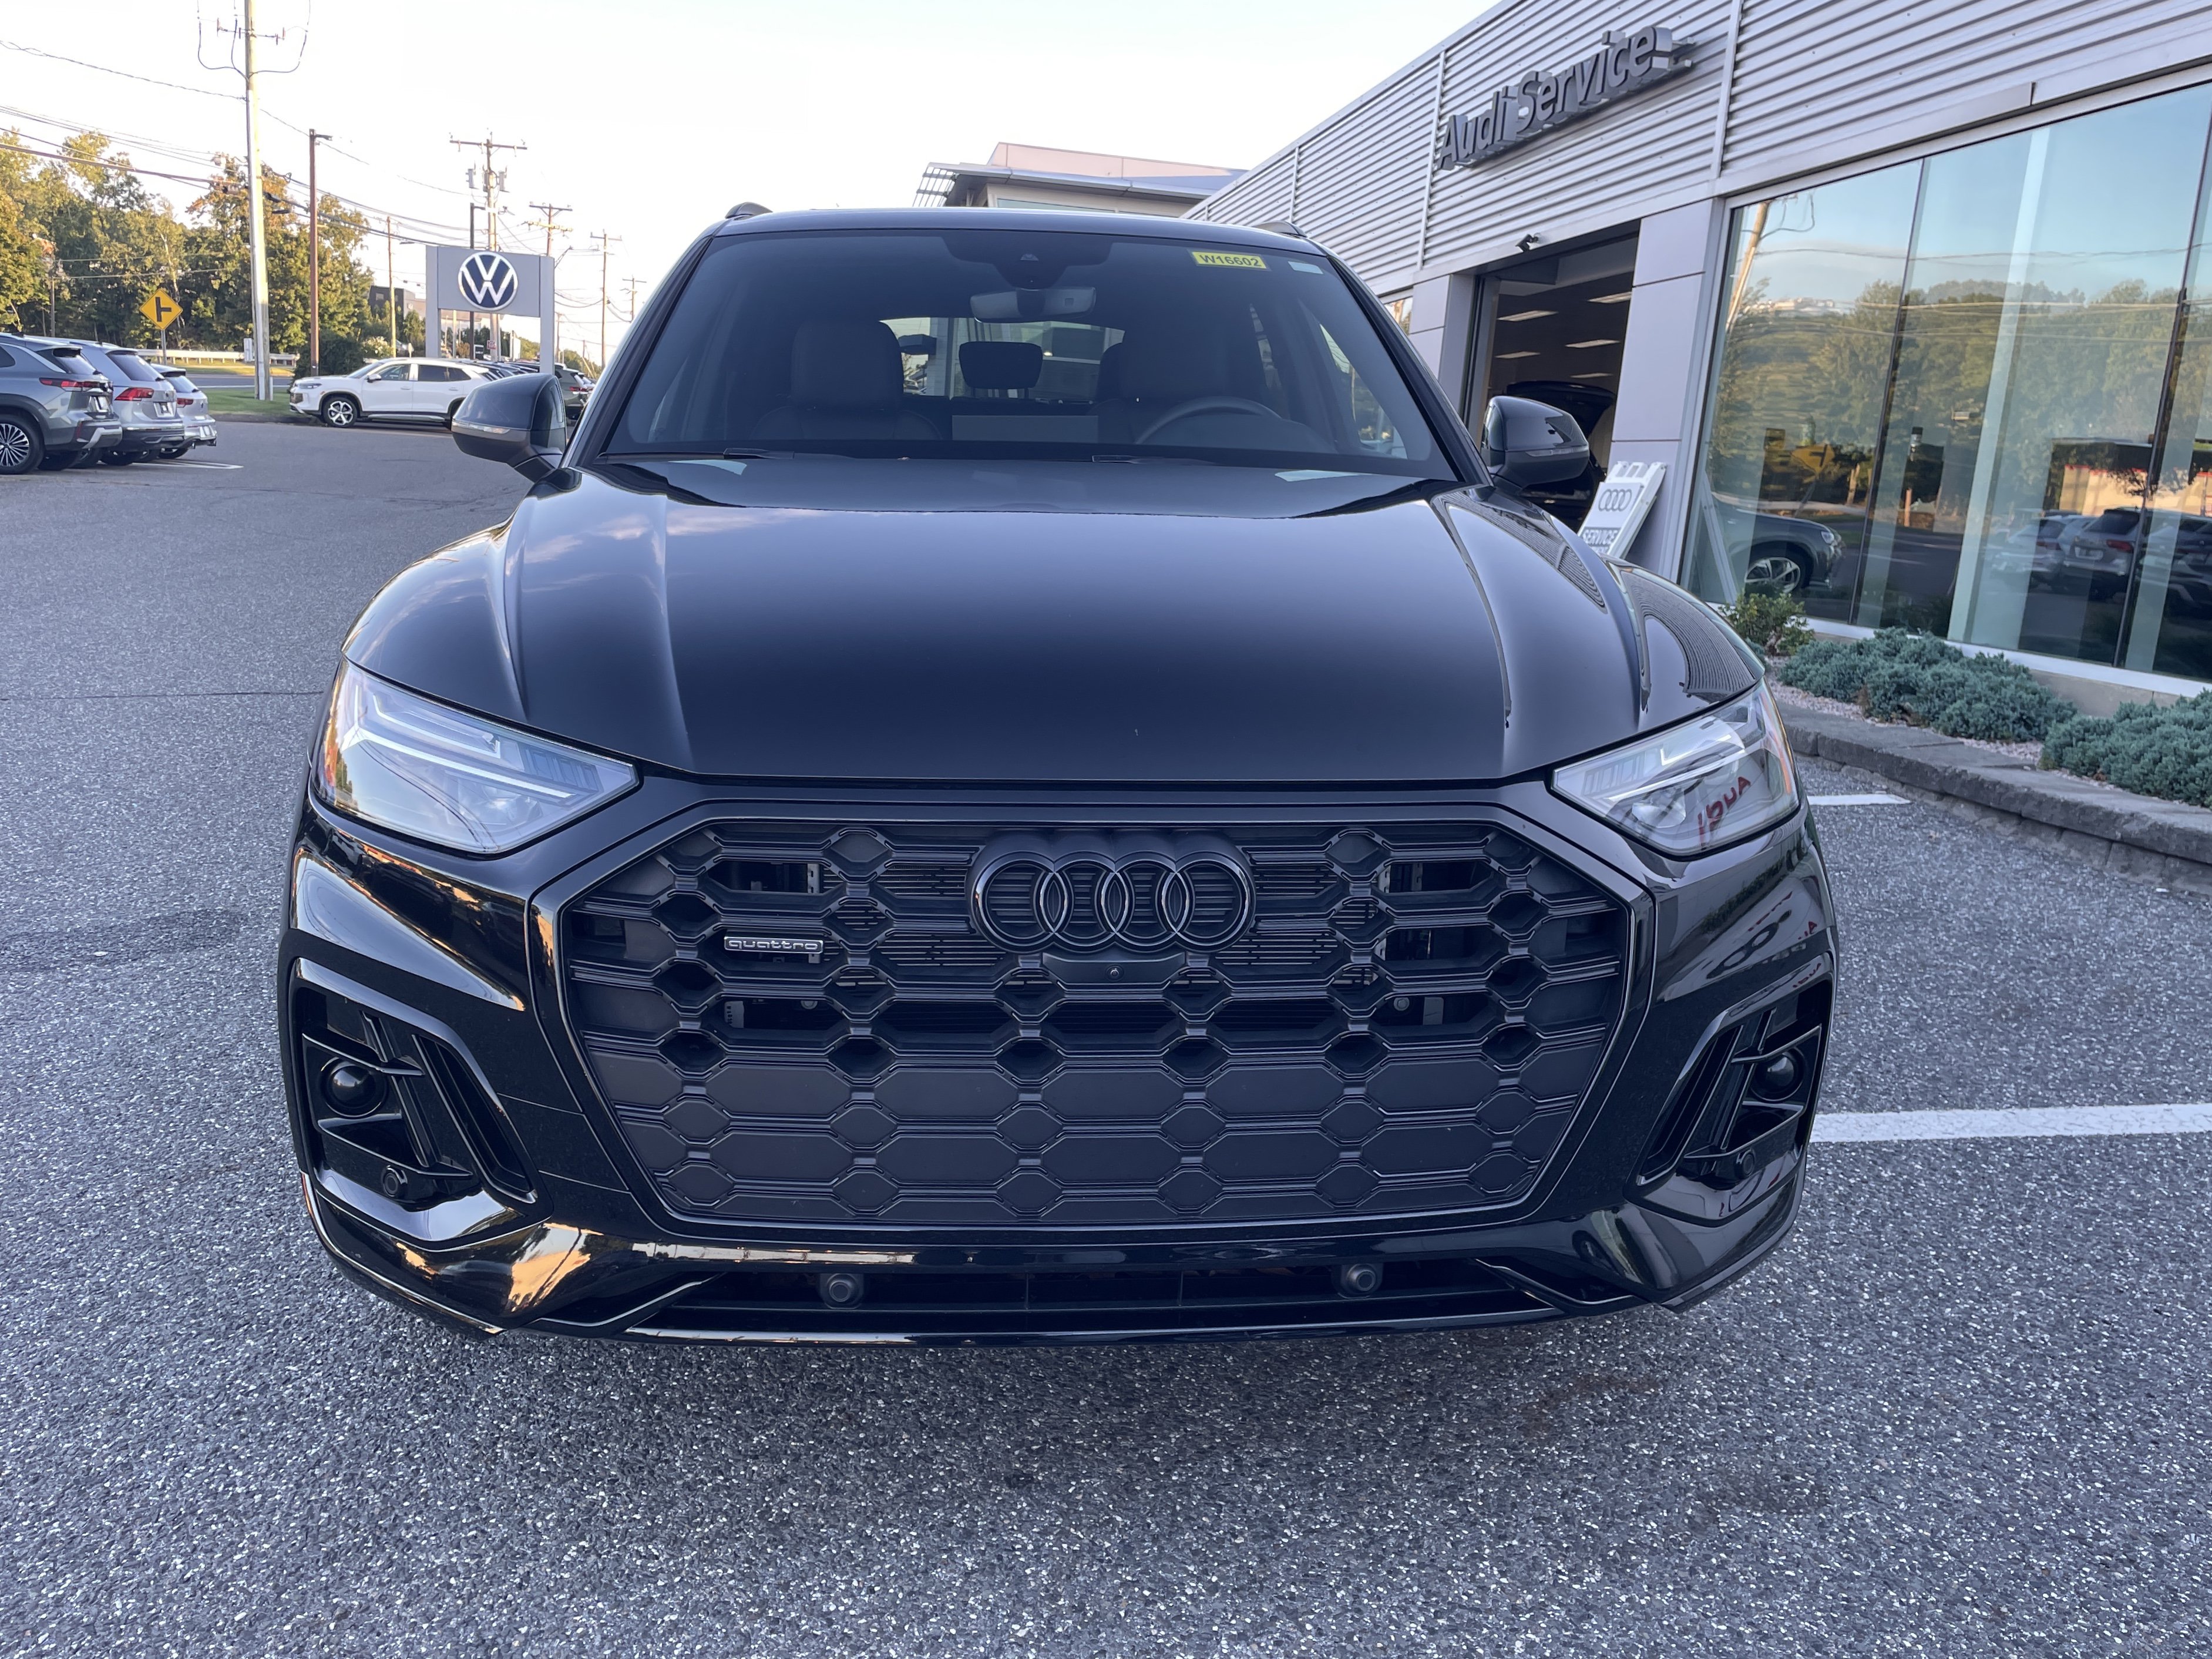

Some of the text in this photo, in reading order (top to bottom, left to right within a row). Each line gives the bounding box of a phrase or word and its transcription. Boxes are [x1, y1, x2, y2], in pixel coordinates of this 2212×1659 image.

[1438, 26, 1672, 170] Audi Service
[1199, 254, 1262, 267] W16602
[459, 253, 516, 307] VW
[1582, 529, 1618, 545] SERVICE
[728, 940, 818, 950] quattro
